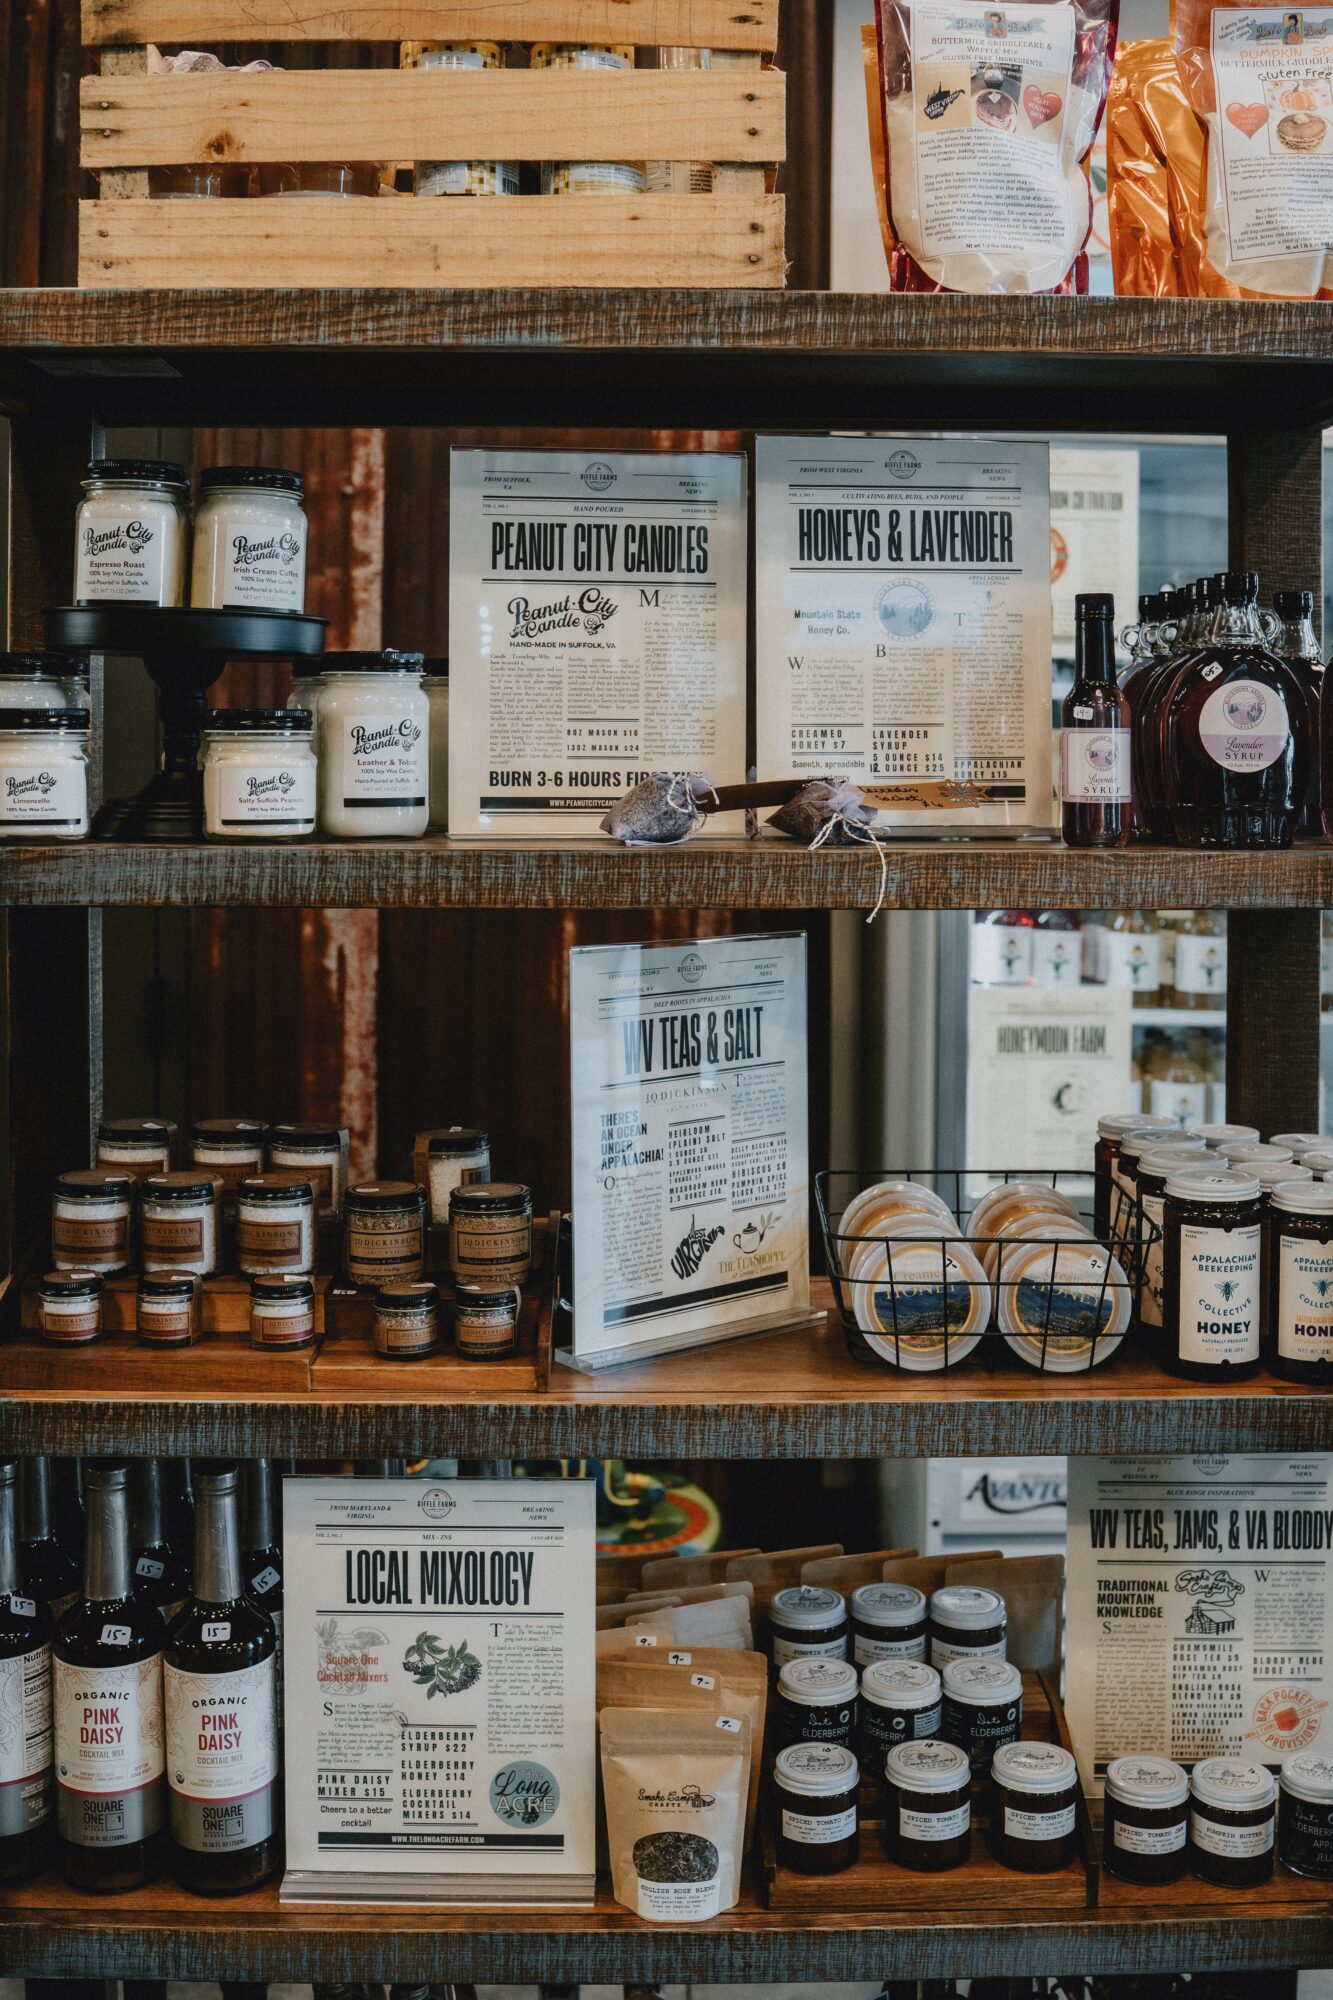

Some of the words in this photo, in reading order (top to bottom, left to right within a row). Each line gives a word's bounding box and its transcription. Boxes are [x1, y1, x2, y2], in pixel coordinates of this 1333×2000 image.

[931, 37, 986, 46] BUTTERMILK
[988, 40, 1044, 49] GRIDDLECAKE
[1046, 42, 1052, 50] &
[967, 46, 999, 54] WAFFLE
[1239, 47, 1302, 60] PUMPKIN
[995, 55, 1043, 67] INGREDIENTS
[1258, 69, 1300, 81] Gluten
[1305, 68, 1332, 80] Free
[580, 473, 598, 481] RIFFLE
[573, 505, 593, 513] HAND
[83, 527, 121, 547] Peanut
[126, 521, 153, 544] City
[799, 508, 880, 562] HONEYS
[888, 510, 903, 562] &
[910, 510, 1013, 563] LAVENDER
[91, 537, 128, 556] Candle
[491, 521, 567, 571] PEANUT
[573, 523, 618, 572] CITY
[624, 524, 708, 574] CANDLES
[90, 561, 121, 570] Espresso
[123, 561, 145, 569] Roast
[101, 570, 111, 578] Soy
[233, 566, 250, 574] Irish
[252, 567, 277, 576] Cream
[279, 569, 298, 578] Coffee
[507, 596, 570, 626] Peanut
[578, 588, 618, 620] City
[525, 612, 580, 638] Candle
[509, 641, 557, 649] HAND-MADE
[792, 730, 842, 739] CREAMED
[873, 730, 929, 739] LAVENDER
[792, 741, 826, 750] HONEY
[833, 741, 845, 750] $7
[873, 742, 908, 750] SYRUP
[1224, 737, 1264, 753] Lavender
[873, 753, 878, 762] 5
[885, 753, 918, 763] OUNCE
[925, 754, 943, 762] $14
[1225, 752, 1264, 760] SYRUP
[885, 764, 918, 773] OUNCE
[925, 764, 945, 772] $25
[489, 770, 532, 787] BURN
[537, 771, 563, 787] 3-6
[569, 771, 621, 787] HOURS
[624, 1018, 654, 1075] WV
[659, 1013, 701, 1070] TEAS
[706, 1011, 719, 1064] &
[724, 1007, 763, 1062] SALT
[998, 1025, 1068, 1054] HONEYMOON
[1073, 1025, 1106, 1053] FARM
[600, 1110, 639, 1127] THERE'S
[601, 1127, 614, 1140] AN
[616, 1123, 648, 1140] OCEAN
[668, 1124, 711, 1138] HEIRLOOM
[668, 1137, 701, 1149] (PLAIN)
[706, 1132, 726, 1144] SALT
[601, 1140, 633, 1155] UNDER
[600, 1148, 664, 1170] APPALACHIA!
[1192, 1253, 1257, 1264] APPALACHIAN
[1198, 1263, 1253, 1272] BEEKEEPING
[1198, 1297, 1252, 1316] COLLECTIVE
[1197, 1320, 1252, 1334] HONEY
[417, 1500, 436, 1508] RIFFLE
[1089, 1509, 1118, 1549] WV
[1124, 1510, 1169, 1553] TEAS,
[1174, 1510, 1223, 1552] JAMS,
[1228, 1510, 1240, 1549] &
[1246, 1510, 1270, 1549] VA
[346, 1550, 412, 1605] LOCAL
[420, 1550, 534, 1606] MIXOLOGY
[1097, 1580, 1169, 1593] TRADITIONAL
[1097, 1593, 1155, 1605] MOUNTAIN
[1097, 1606, 1163, 1619] KNOWLEDGE
[1173, 1644, 1233, 1652] CHAMOMILE
[326, 1653, 357, 1666] Square
[361, 1654, 379, 1665] One
[1253, 1657, 1292, 1665] BLOODY
[1300, 1657, 1324, 1665] BLUE
[357, 1671, 389, 1682] Mixers
[75, 1690, 130, 1702] ORGANIC
[83, 1707, 121, 1725] PINK
[80, 1726, 123, 1745] DAISY
[401, 1731, 474, 1741] ELDERBERRY
[802, 1726, 849, 1738] ELDERBERRY
[1266, 1717, 1318, 1750] PROVISIONS
[401, 1743, 438, 1752] SYRUP
[445, 1743, 467, 1752] $22
[79, 1749, 109, 1759] COCKTAIL
[110, 1749, 125, 1758] MIX
[317, 1775, 347, 1785] PINK
[354, 1775, 390, 1785] DAISY
[401, 1772, 438, 1781] HONEY
[446, 1772, 466, 1781] $14
[495, 1770, 552, 1797] Long
[317, 1787, 357, 1796] MIXER
[364, 1787, 385, 1797] $15
[638, 1788, 666, 1802] Smoke
[668, 1789, 692, 1803] Camp
[83, 1798, 124, 1812] SQUARE
[320, 1805, 348, 1814] Cheers
[349, 1806, 357, 1814] to
[365, 1805, 393, 1815] better
[495, 1796, 555, 1814] ACRE
[83, 1813, 104, 1825] ONE
[341, 1819, 372, 1828] cocktail
[788, 1816, 813, 1825] SPICED
[816, 1817, 841, 1826] TOMATO
[391, 1835, 484, 1844] WWW.THELONGACREFARM.COM
[641, 1884, 670, 1894] ENGLISH
[674, 1886, 691, 1894] ROSE
[695, 1885, 716, 1894] BLEND
